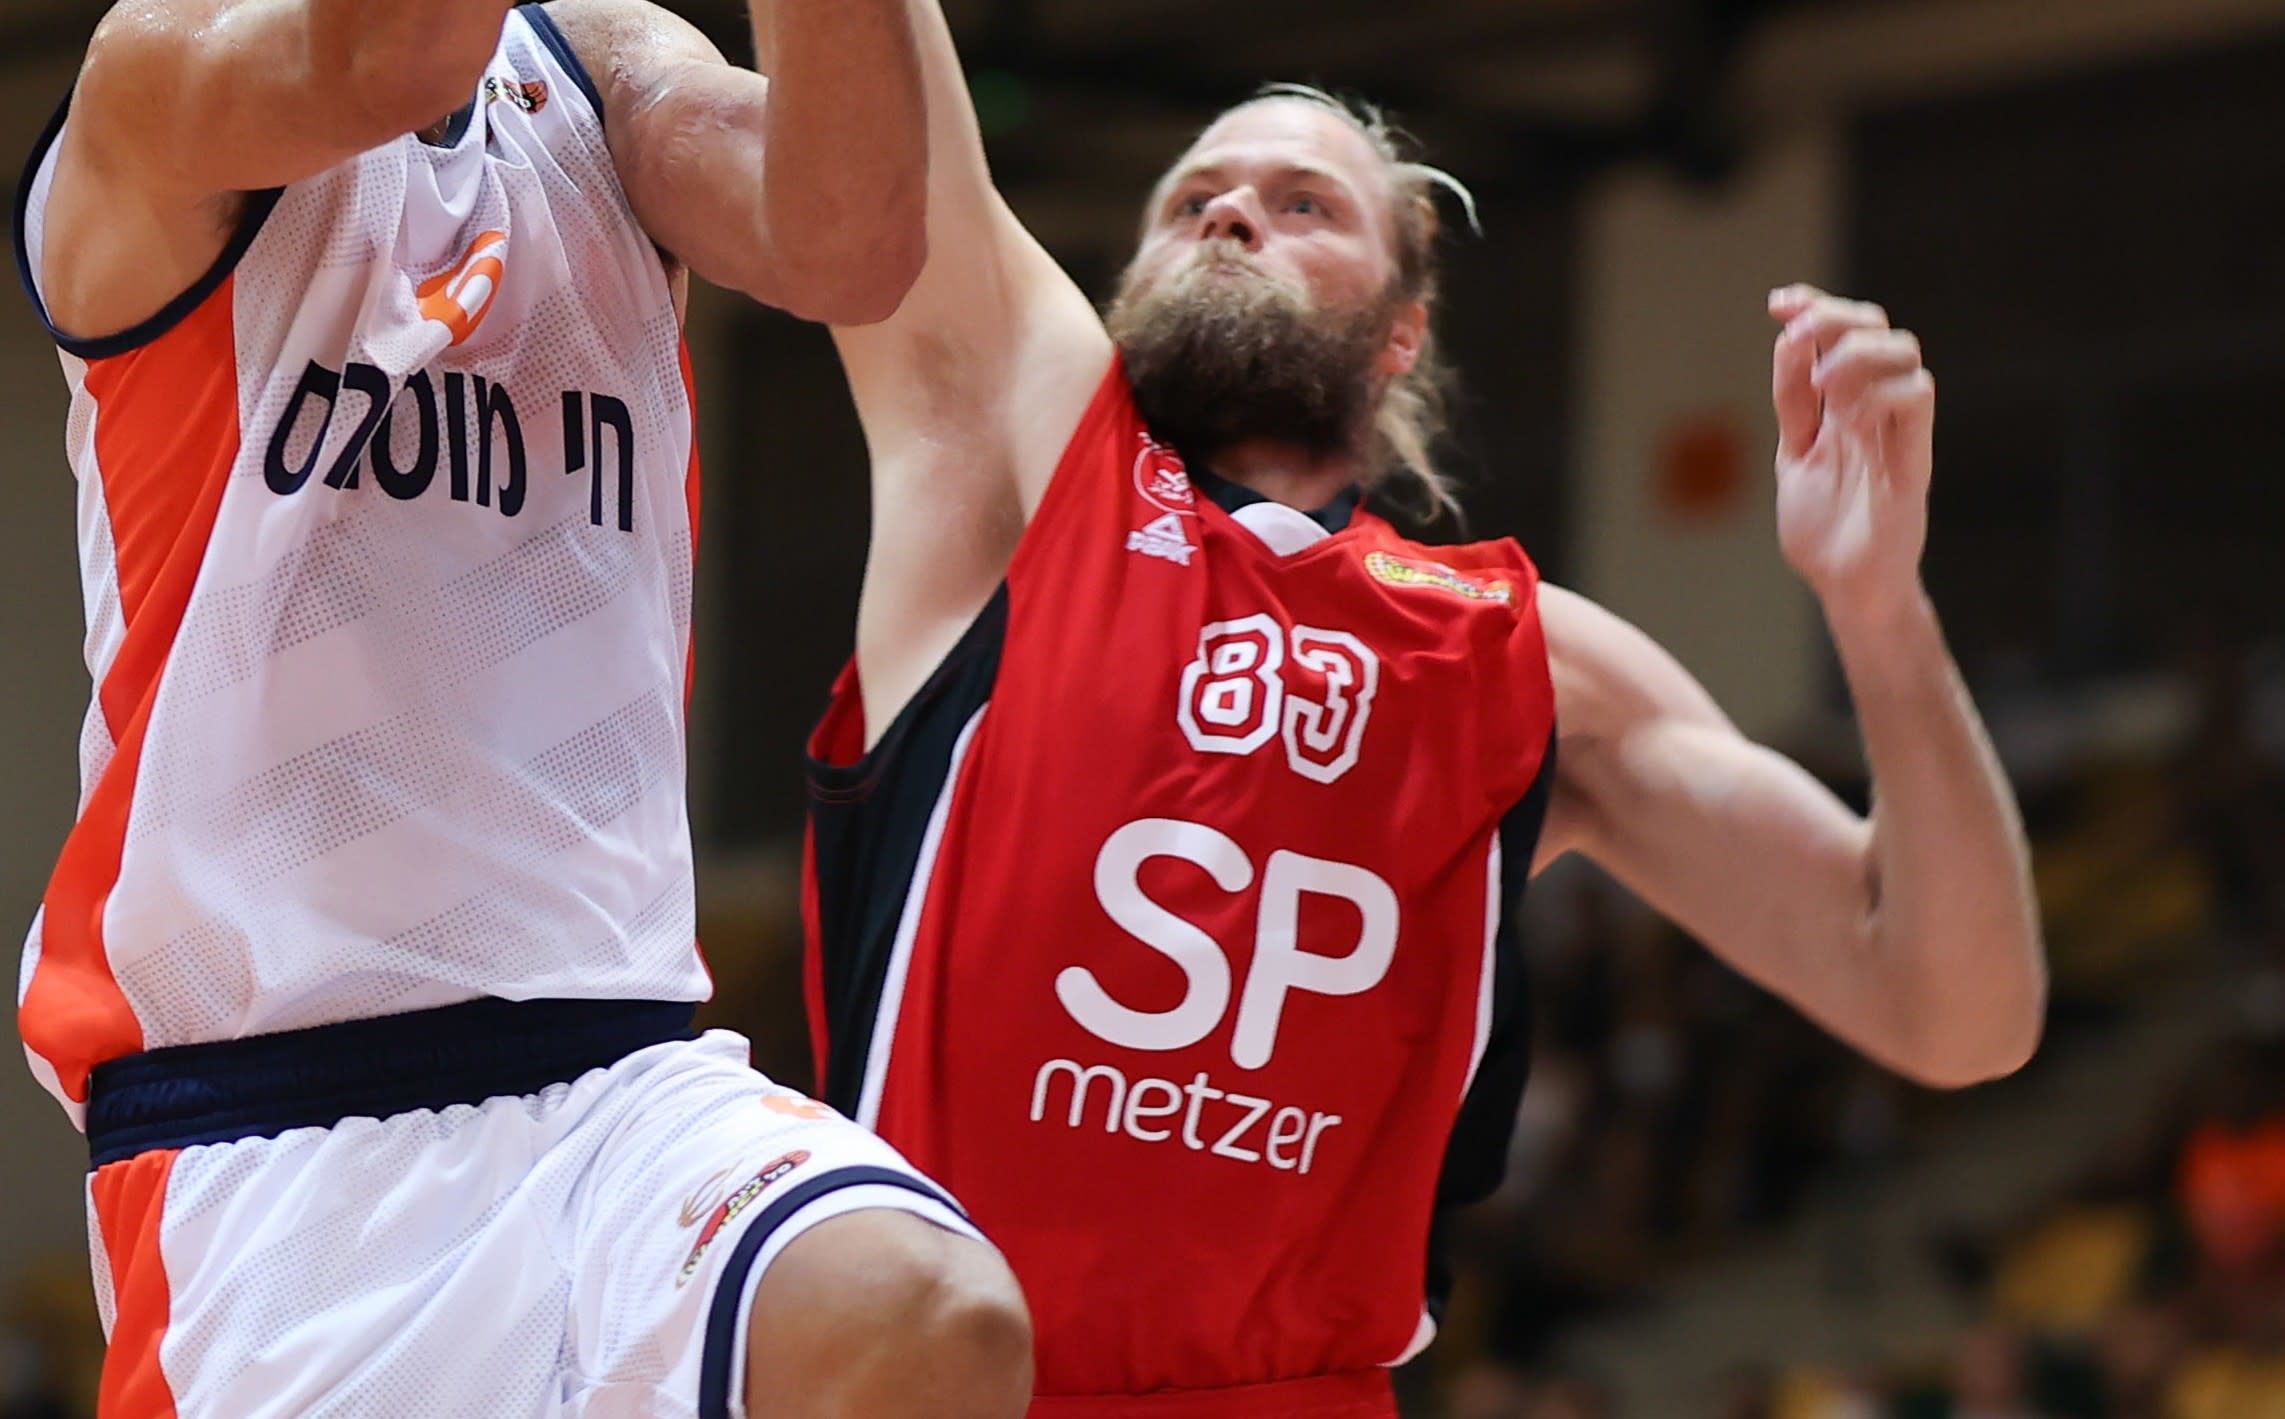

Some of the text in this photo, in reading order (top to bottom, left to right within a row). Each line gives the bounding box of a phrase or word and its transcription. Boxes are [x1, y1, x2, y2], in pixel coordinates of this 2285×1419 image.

[560, 390, 634, 533] חי
[1177, 612, 1379, 784] 83
[1054, 817, 1400, 1070] SP
[1030, 1059, 1343, 1175] metzer
